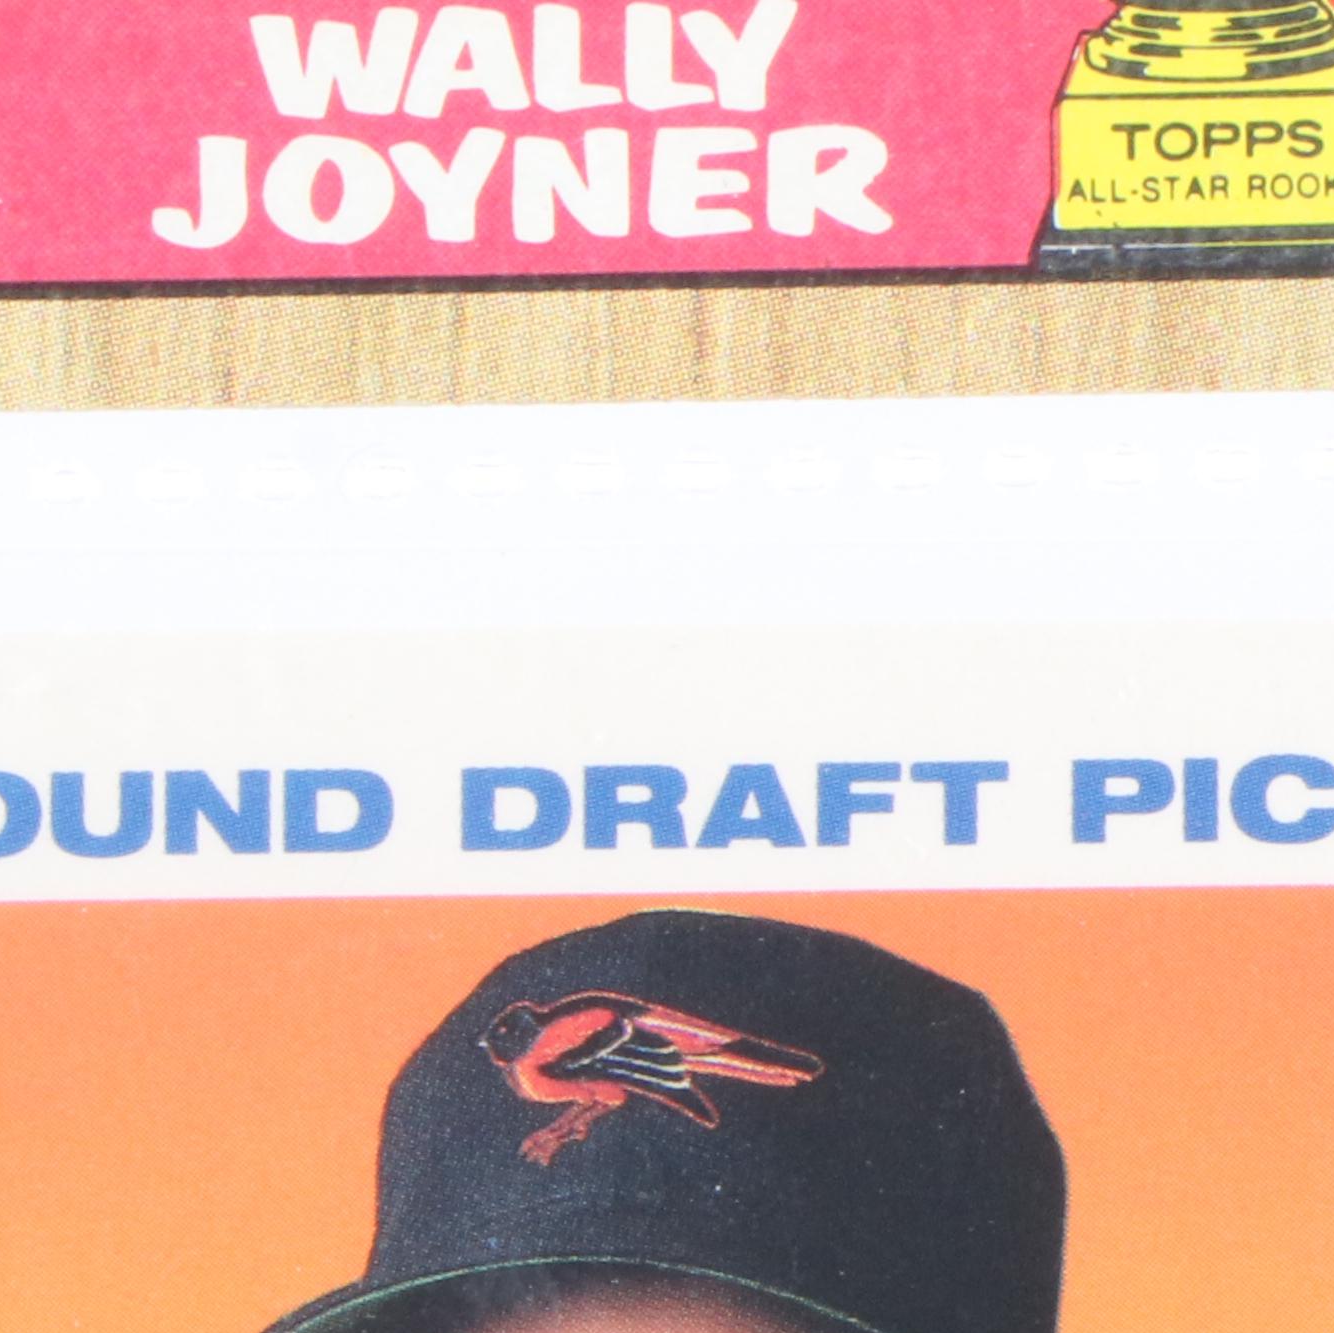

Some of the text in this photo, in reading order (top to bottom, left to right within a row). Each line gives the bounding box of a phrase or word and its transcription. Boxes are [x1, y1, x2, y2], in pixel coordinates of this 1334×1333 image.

[249, 0, 799, 119] WALLY
[1111, 120, 1325, 161] TOPPS
[151, 124, 894, 249] JOYNER
[1068, 174, 1229, 203] ALL-STAR
[460, 761, 1009, 852] DRAFT
